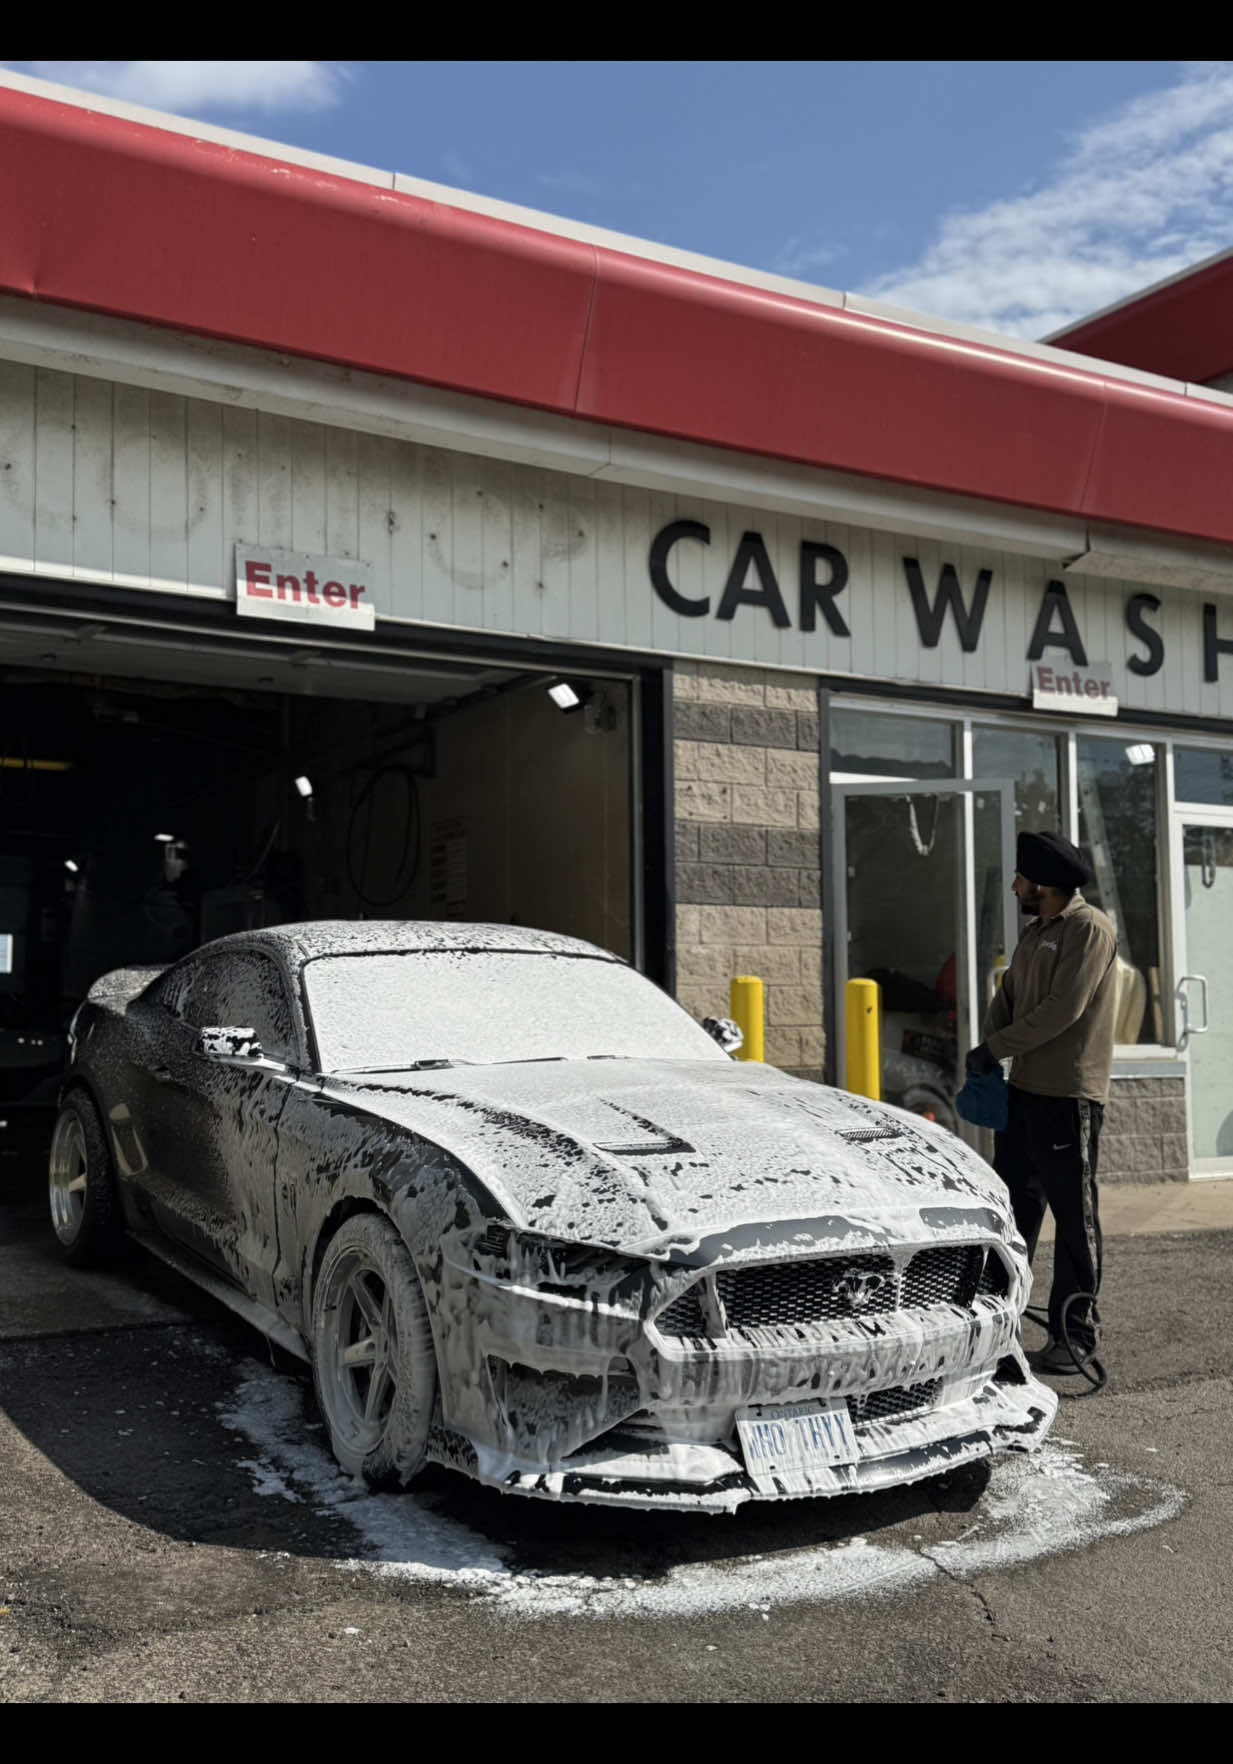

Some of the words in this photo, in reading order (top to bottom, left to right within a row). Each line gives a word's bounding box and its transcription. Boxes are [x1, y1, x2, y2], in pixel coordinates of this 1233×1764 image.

[245, 560, 366, 609] Enter
[648, 519, 852, 638] CAR
[1036, 666, 1111, 700] Enter
